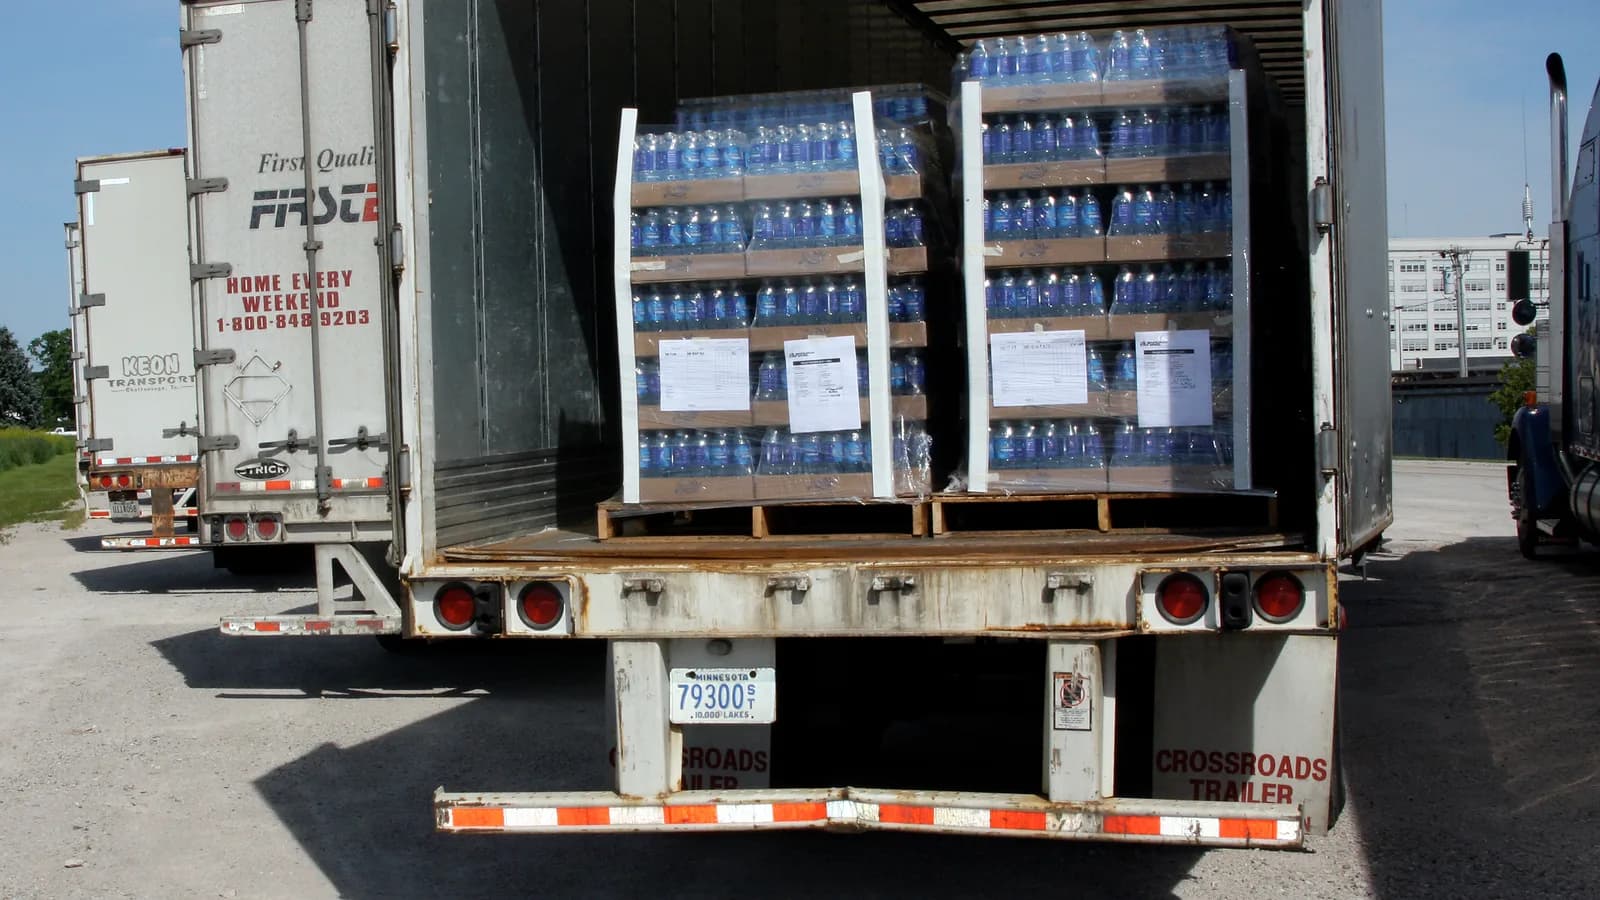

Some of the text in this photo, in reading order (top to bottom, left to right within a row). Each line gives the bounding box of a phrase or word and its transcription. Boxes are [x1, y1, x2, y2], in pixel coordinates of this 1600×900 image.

[317, 146, 378, 173] Quali
[226, 269, 353, 294] HOME EVERY
[242, 291, 339, 313] WEEKEND
[216, 309, 370, 333] 1-800-8489203
[122, 352, 180, 377] KEON
[107, 375, 197, 388] TRANSPORT
[695, 673, 750, 682] MINNESOTA
[677, 683, 745, 711] 79300
[723, 710, 750, 719] LAKES
[1155, 749, 1328, 783] CROSSROADS
[1189, 779, 1294, 805] TRAILER
